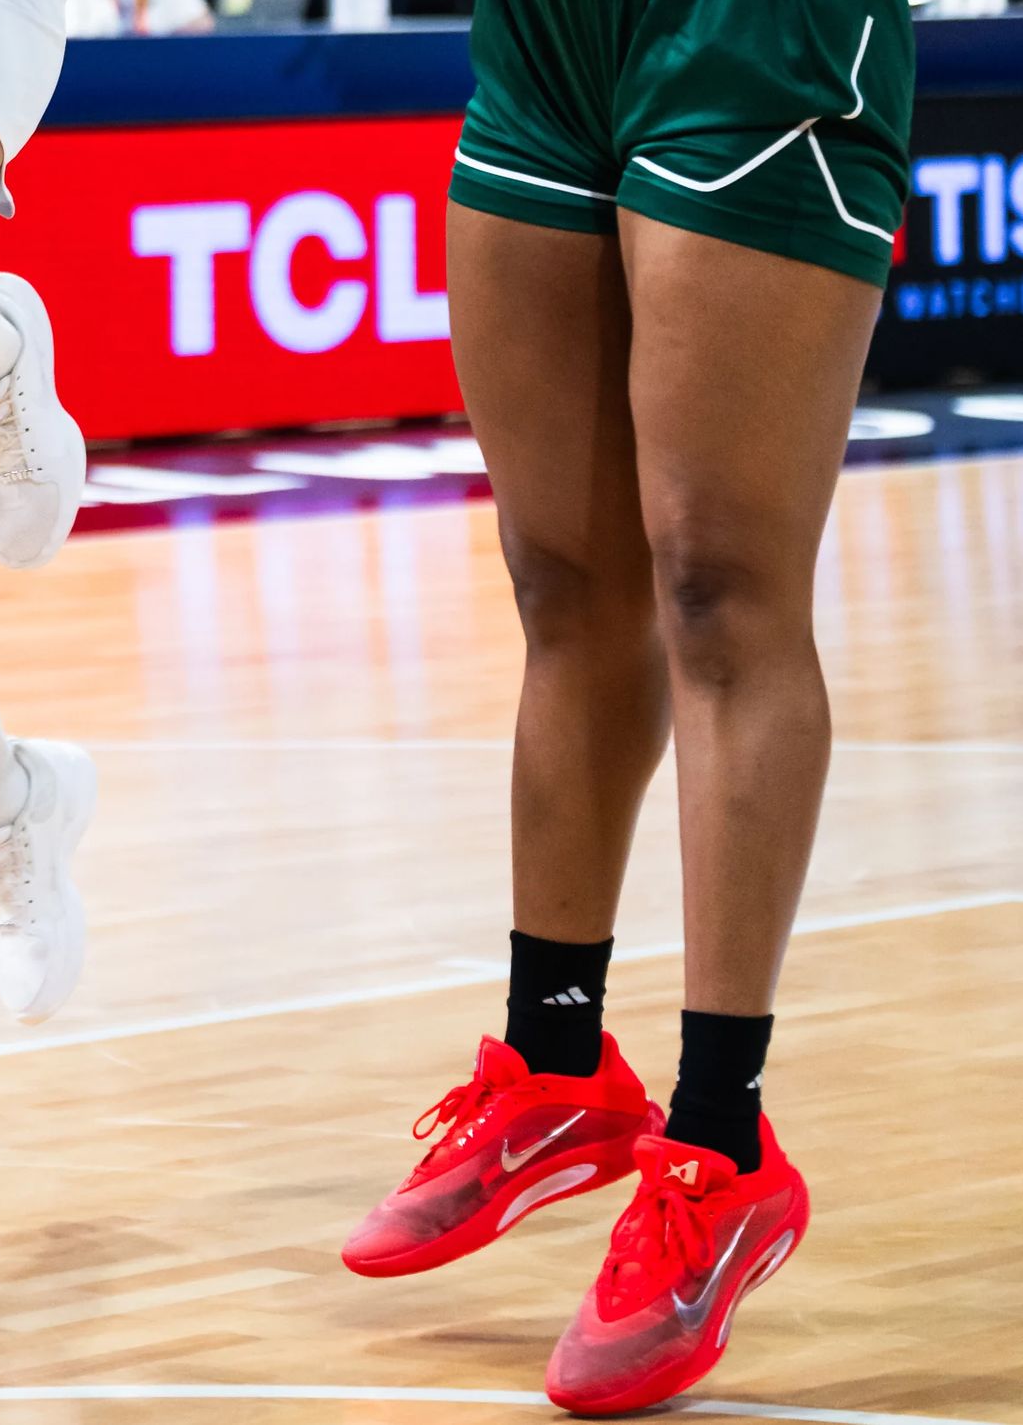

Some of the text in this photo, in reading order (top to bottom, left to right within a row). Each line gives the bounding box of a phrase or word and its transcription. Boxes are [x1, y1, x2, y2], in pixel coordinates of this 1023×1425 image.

[914, 154, 1023, 265] TI
[132, 190, 451, 357] TCL
[897, 280, 1023, 321] WATCH
